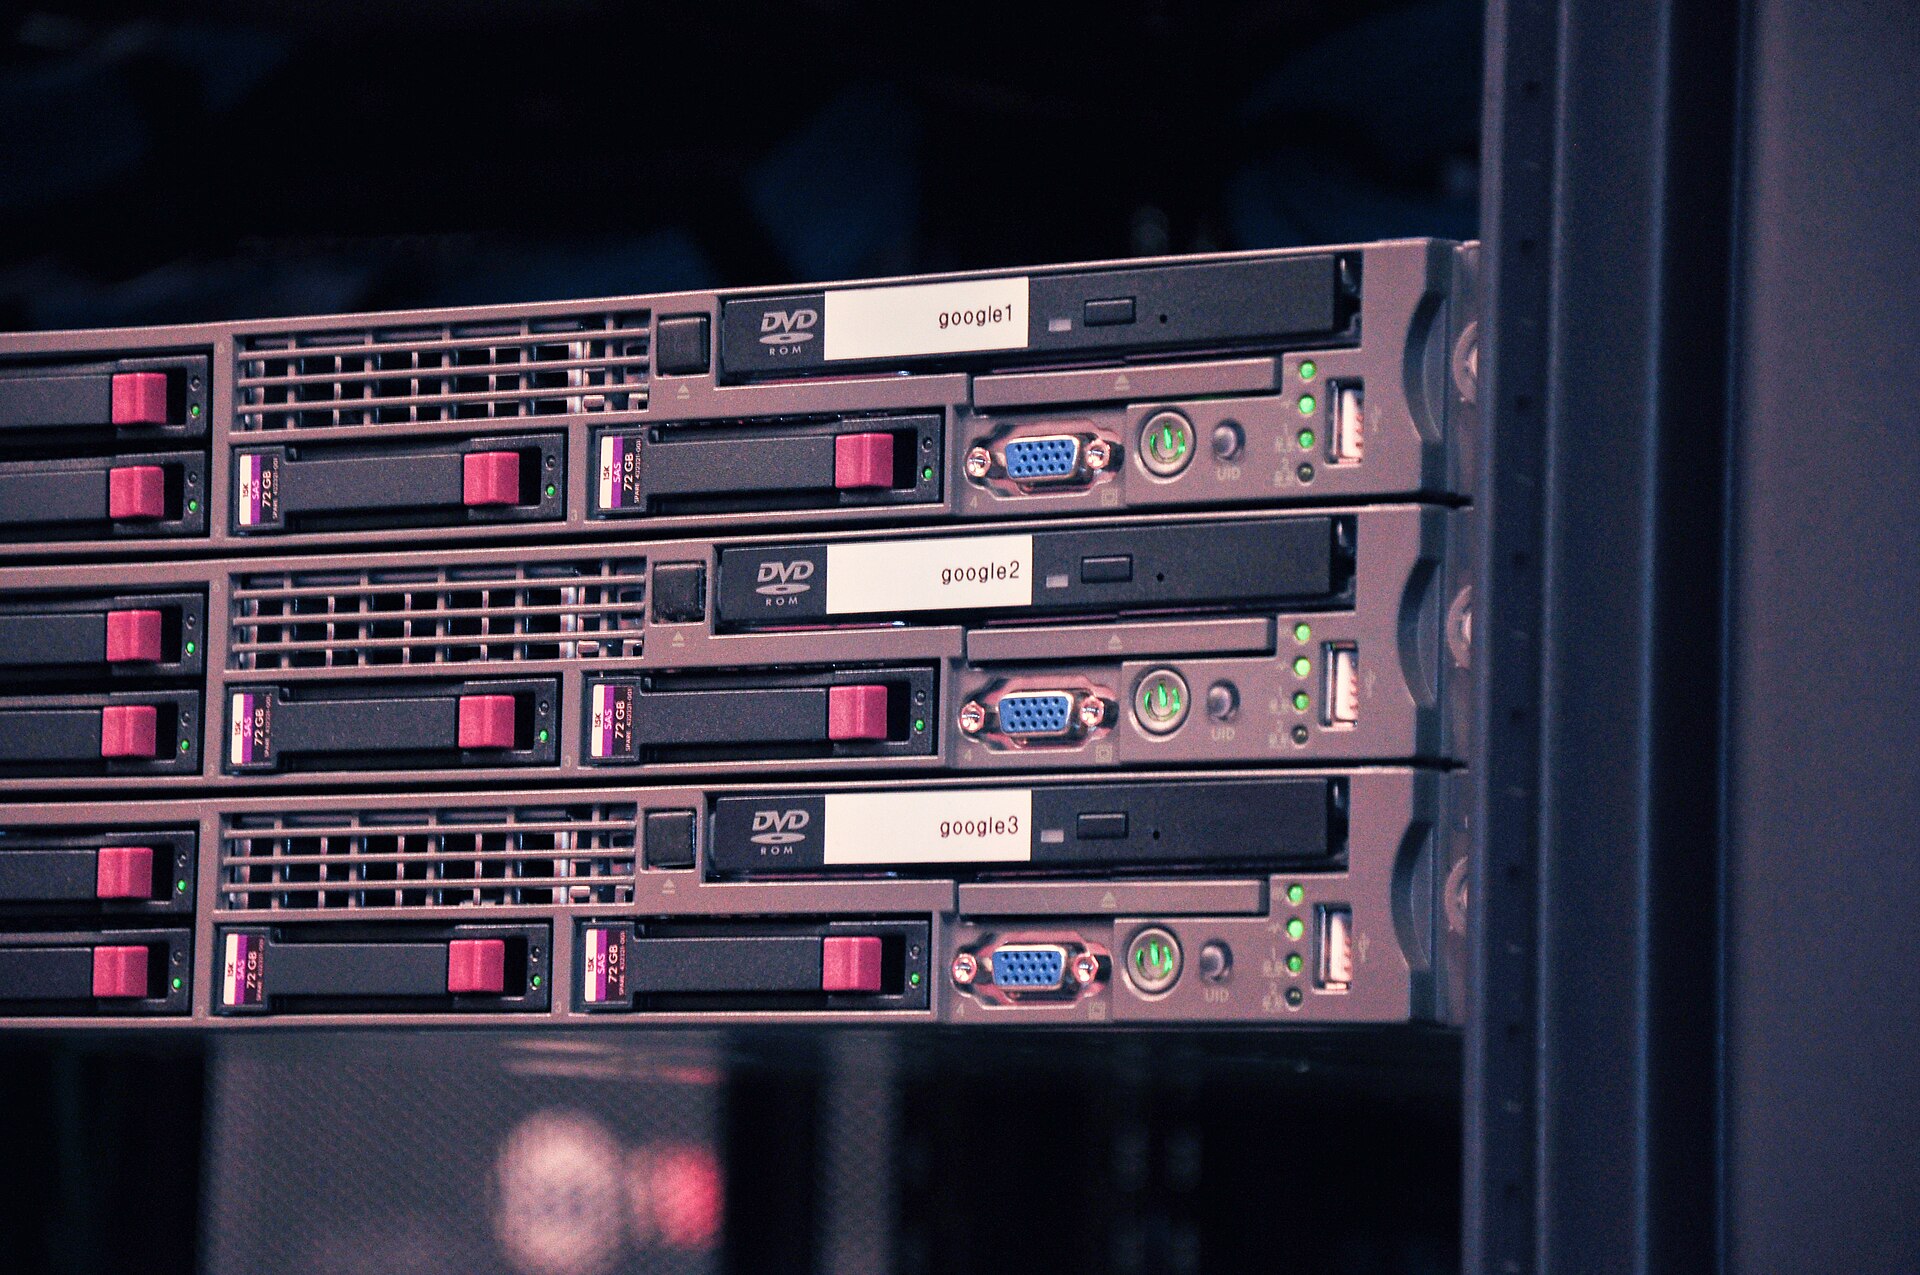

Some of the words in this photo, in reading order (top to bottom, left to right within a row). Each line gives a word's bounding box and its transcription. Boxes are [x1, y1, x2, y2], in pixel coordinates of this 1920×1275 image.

[760, 309, 818, 333] DVD
[938, 304, 1012, 329] google1
[769, 346, 802, 356] ROM
[624, 453, 634, 472] GB
[262, 470, 271, 489] GB
[613, 462, 621, 483] SAS
[252, 480, 260, 500] SAS
[624, 474, 633, 492] 72
[262, 491, 271, 508] 72
[757, 560, 815, 584] DVD
[942, 561, 1020, 585] google2
[765, 597, 798, 606] ROM
[255, 708, 264, 727] GB
[604, 708, 612, 730] SAS
[616, 701, 625, 720] GB
[254, 730, 263, 746] 72
[615, 722, 624, 738] 72
[752, 810, 810, 833] DVD
[940, 816, 1018, 837] google3
[760, 846, 793, 856] ROM
[248, 951, 257, 970] GB
[609, 944, 618, 964] GB
[247, 973, 256, 989] 72
[608, 966, 617, 983] 72
